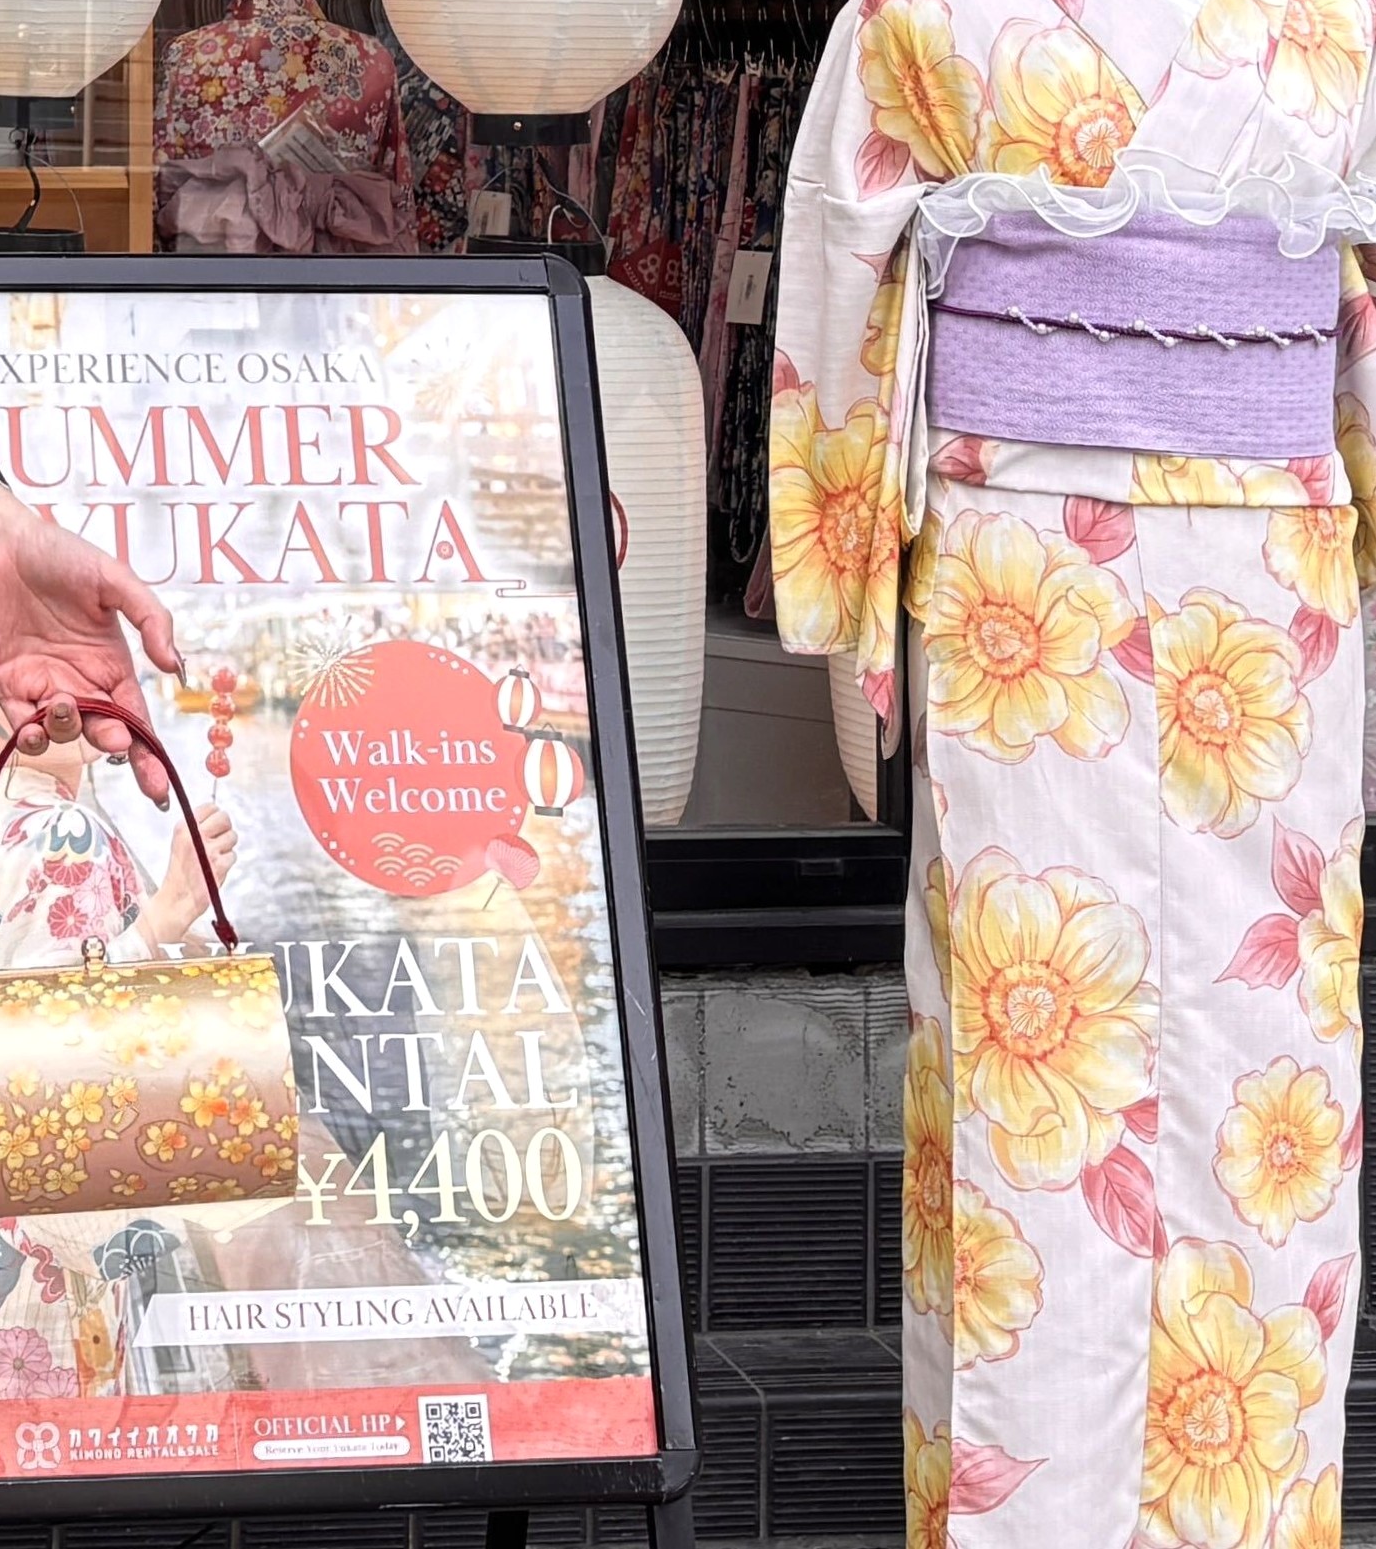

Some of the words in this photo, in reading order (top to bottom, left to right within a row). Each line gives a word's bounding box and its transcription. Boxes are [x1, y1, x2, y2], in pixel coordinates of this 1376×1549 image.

[237, 353, 377, 384] OSAKA
[320, 730, 497, 766] Walk-ins
[317, 777, 507, 814] Welcome
[158, 937, 573, 1017] KATA
[297, 1030, 579, 1114] NTAL
[296, 1127, 583, 1238] ¥4,400
[189, 1302, 267, 1331] HAIR
[275, 1298, 414, 1329] STYLING
[425, 1292, 598, 1324] AVAILABLE
[254, 1415, 356, 1436] OFFICIAL
[362, 1414, 391, 1433] HP
[69, 1448, 122, 1461] KIMONO
